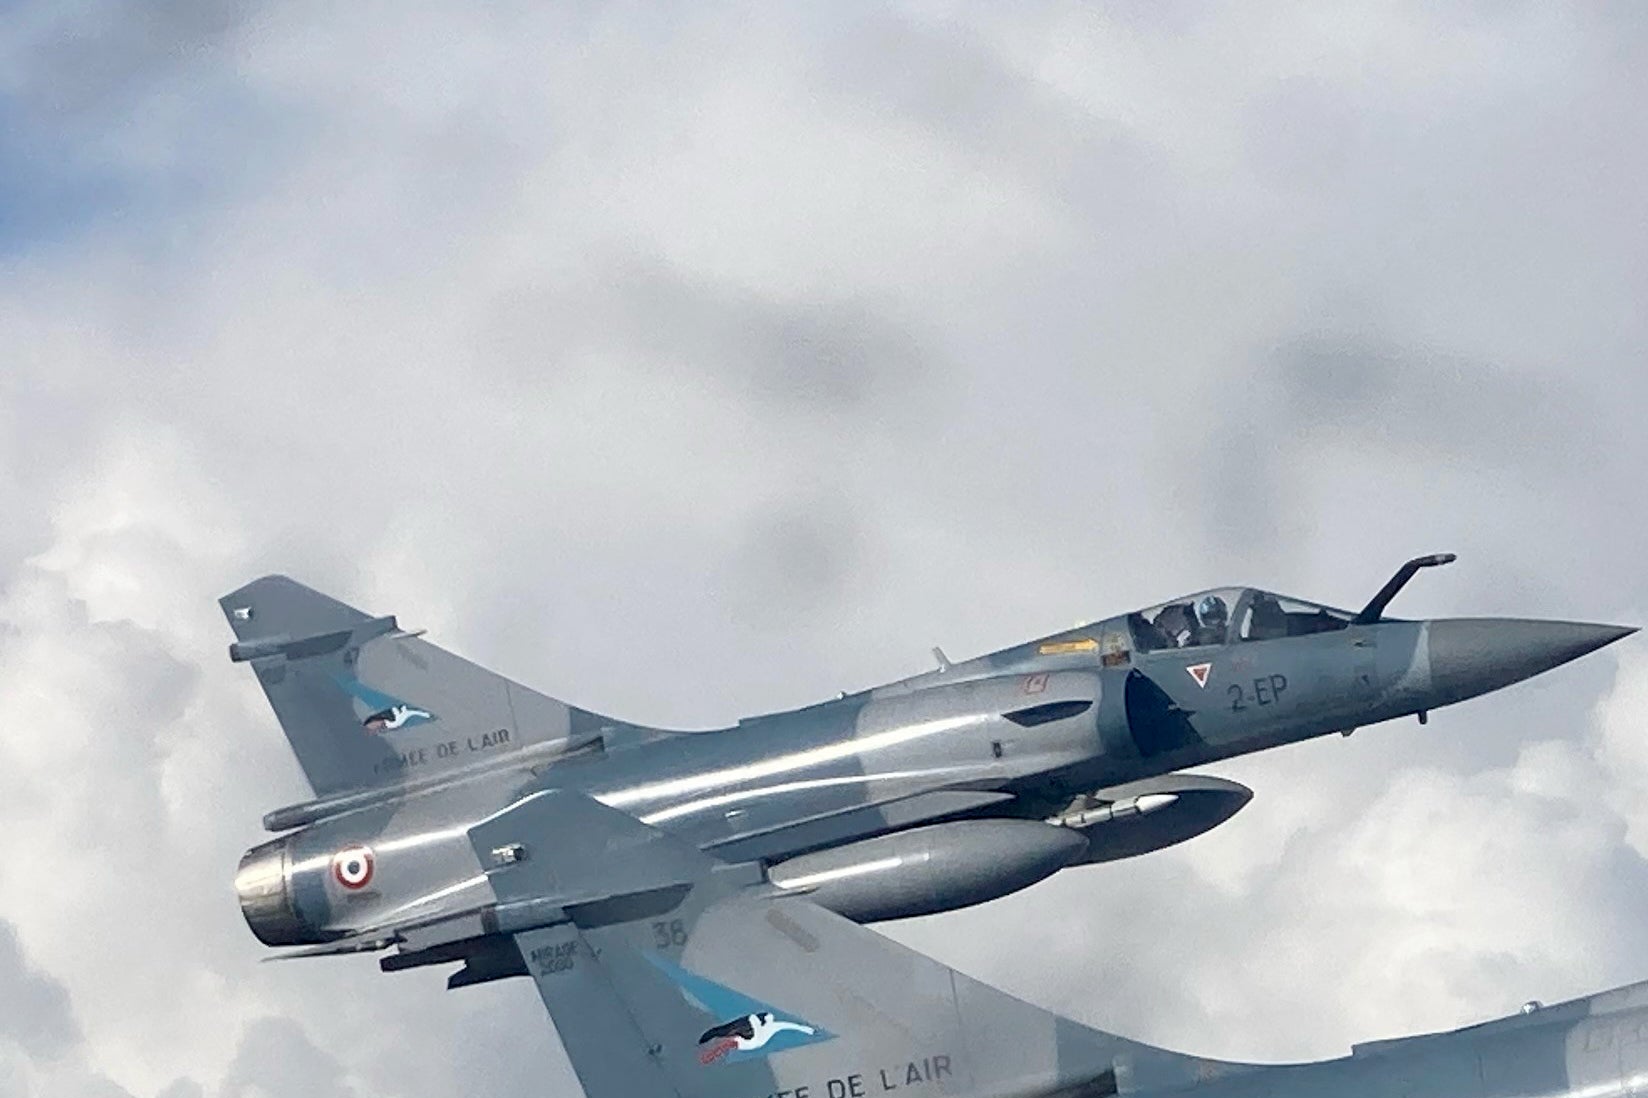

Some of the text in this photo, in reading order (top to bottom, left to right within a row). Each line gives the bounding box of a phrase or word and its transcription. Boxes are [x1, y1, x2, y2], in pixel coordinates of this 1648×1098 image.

[1227, 673, 1287, 713] 2-EP
[436, 741, 459, 759] DE
[652, 918, 689, 949] 38
